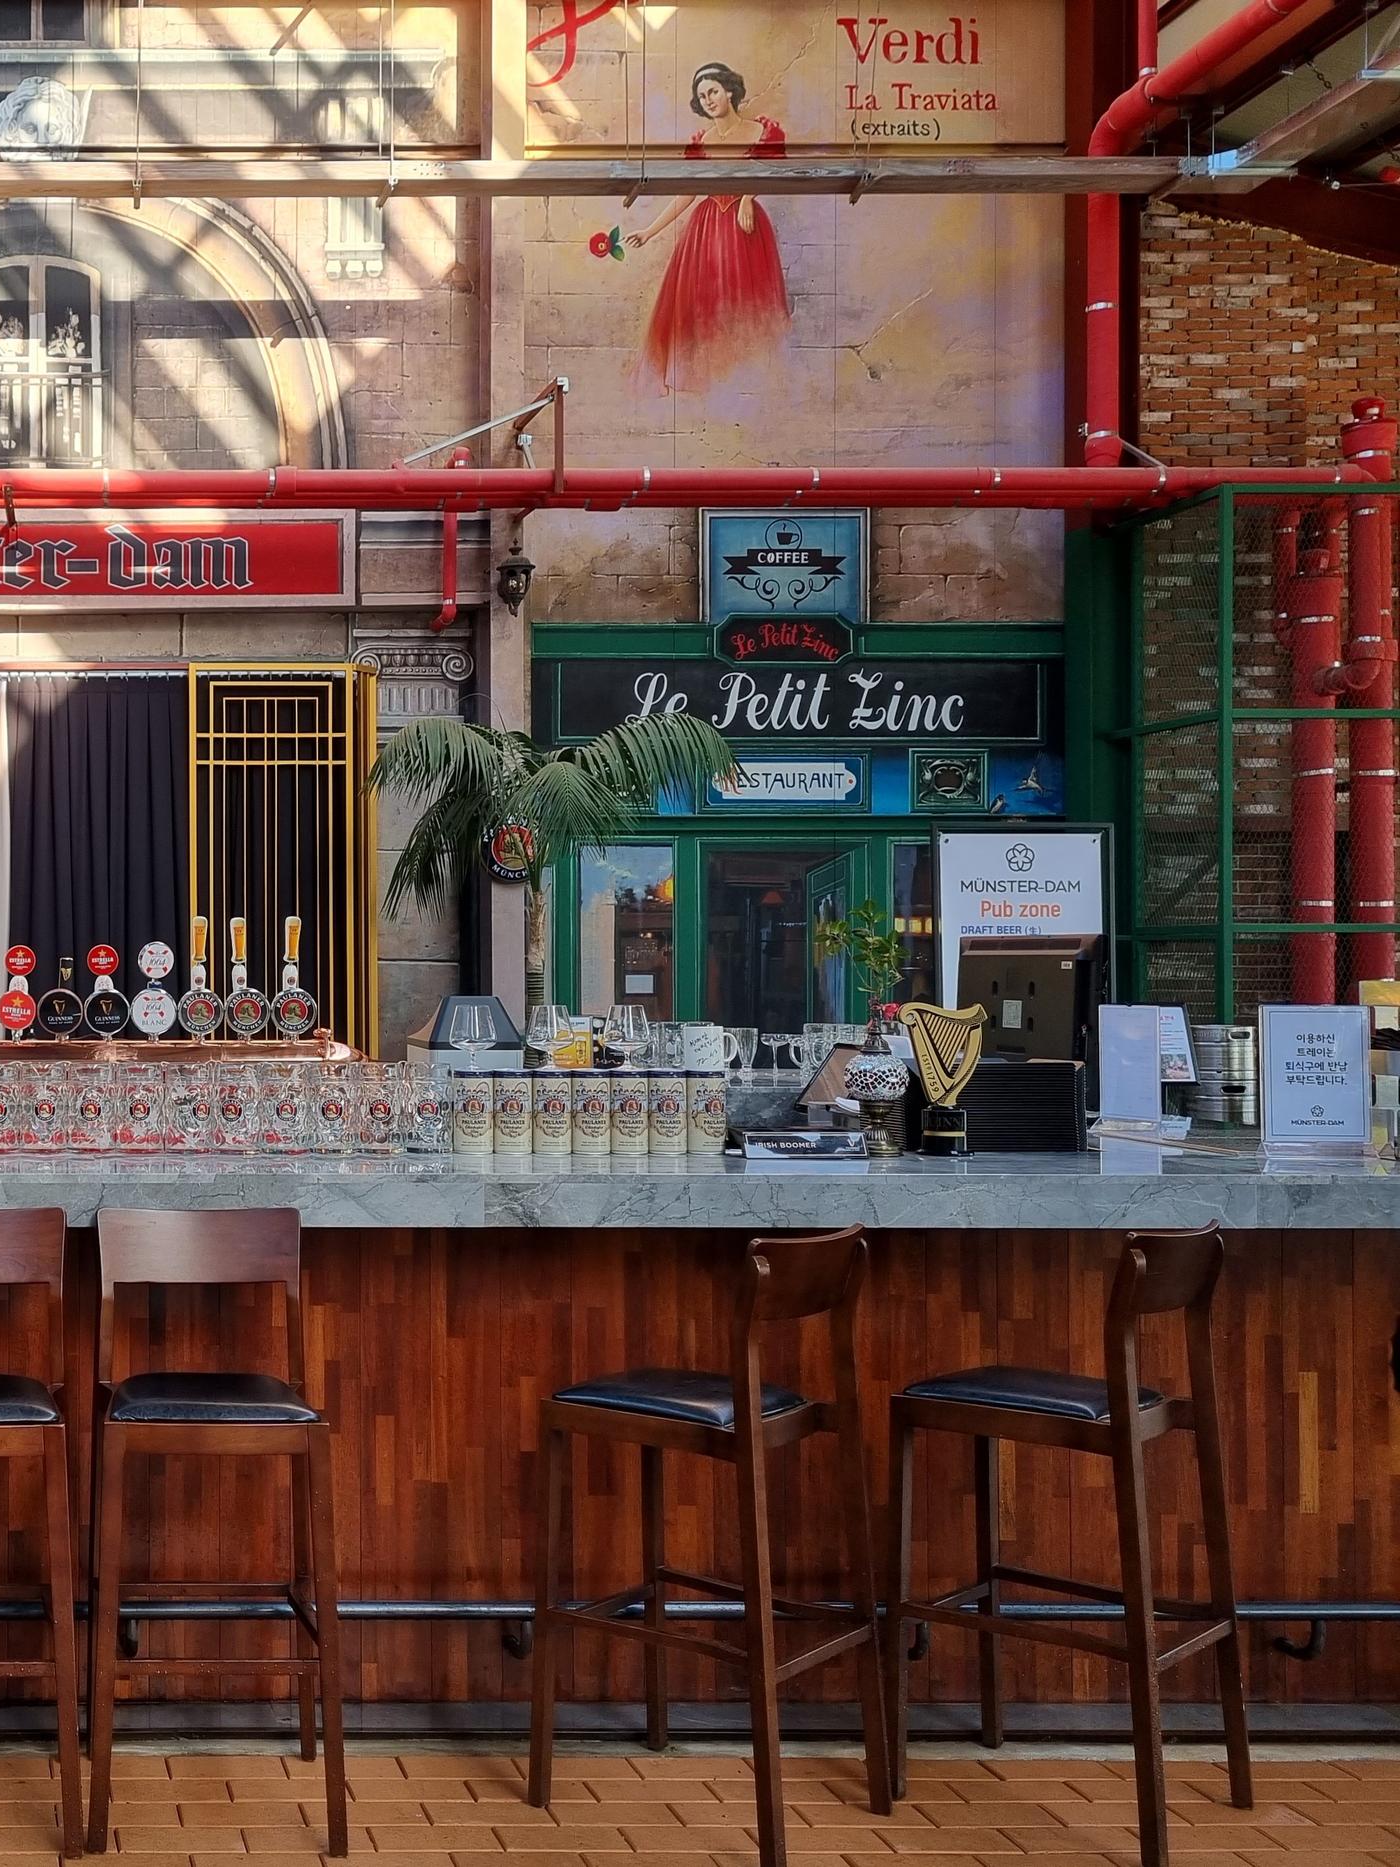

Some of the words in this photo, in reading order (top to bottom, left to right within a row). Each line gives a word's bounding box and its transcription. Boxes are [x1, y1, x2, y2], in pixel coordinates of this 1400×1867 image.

[836, 16, 980, 65] Verdi
[844, 84, 881, 111] La
[891, 83, 999, 111] Traviata
[851, 118, 941, 141] (extraits)
[757, 550, 809, 566] COFFEE
[730, 633, 757, 660] Le
[758, 623, 799, 648] Petit
[800, 623, 839, 661] Zinc
[625, 672, 688, 725] Le
[711, 672, 831, 730] Petit
[848, 668, 964, 732] Zinc
[492, 864, 529, 879] MÜNCH
[960, 877, 1081, 893] MÜNSTER-DAM
[980, 900, 1013, 918] Pub
[1019, 903, 1061, 918] zone
[960, 925, 993, 935] DRAFT
[996, 925, 1022, 935] BEER
[183, 993, 218, 1009] PAULANER
[230, 993, 265, 1008] PAULANER
[276, 993, 311, 1008] PAULANER
[2, 1006, 31, 1015] ESTRELLA
[1295, 1033, 1335, 1044] 이용하신
[1296, 1047, 1336, 1058] 트레이는
[1285, 1060, 1325, 1072] 퇴식구에
[1327, 1060, 1348, 1072] 반납
[926, 1071, 940, 1093] 1759
[1285, 1074, 1348, 1086] 부탁드립니다.
[1290, 1118, 1345, 1126] MÜNSTER-DAM
[755, 1141, 777, 1149] IRISH
[780, 1141, 817, 1149] BOOMER
